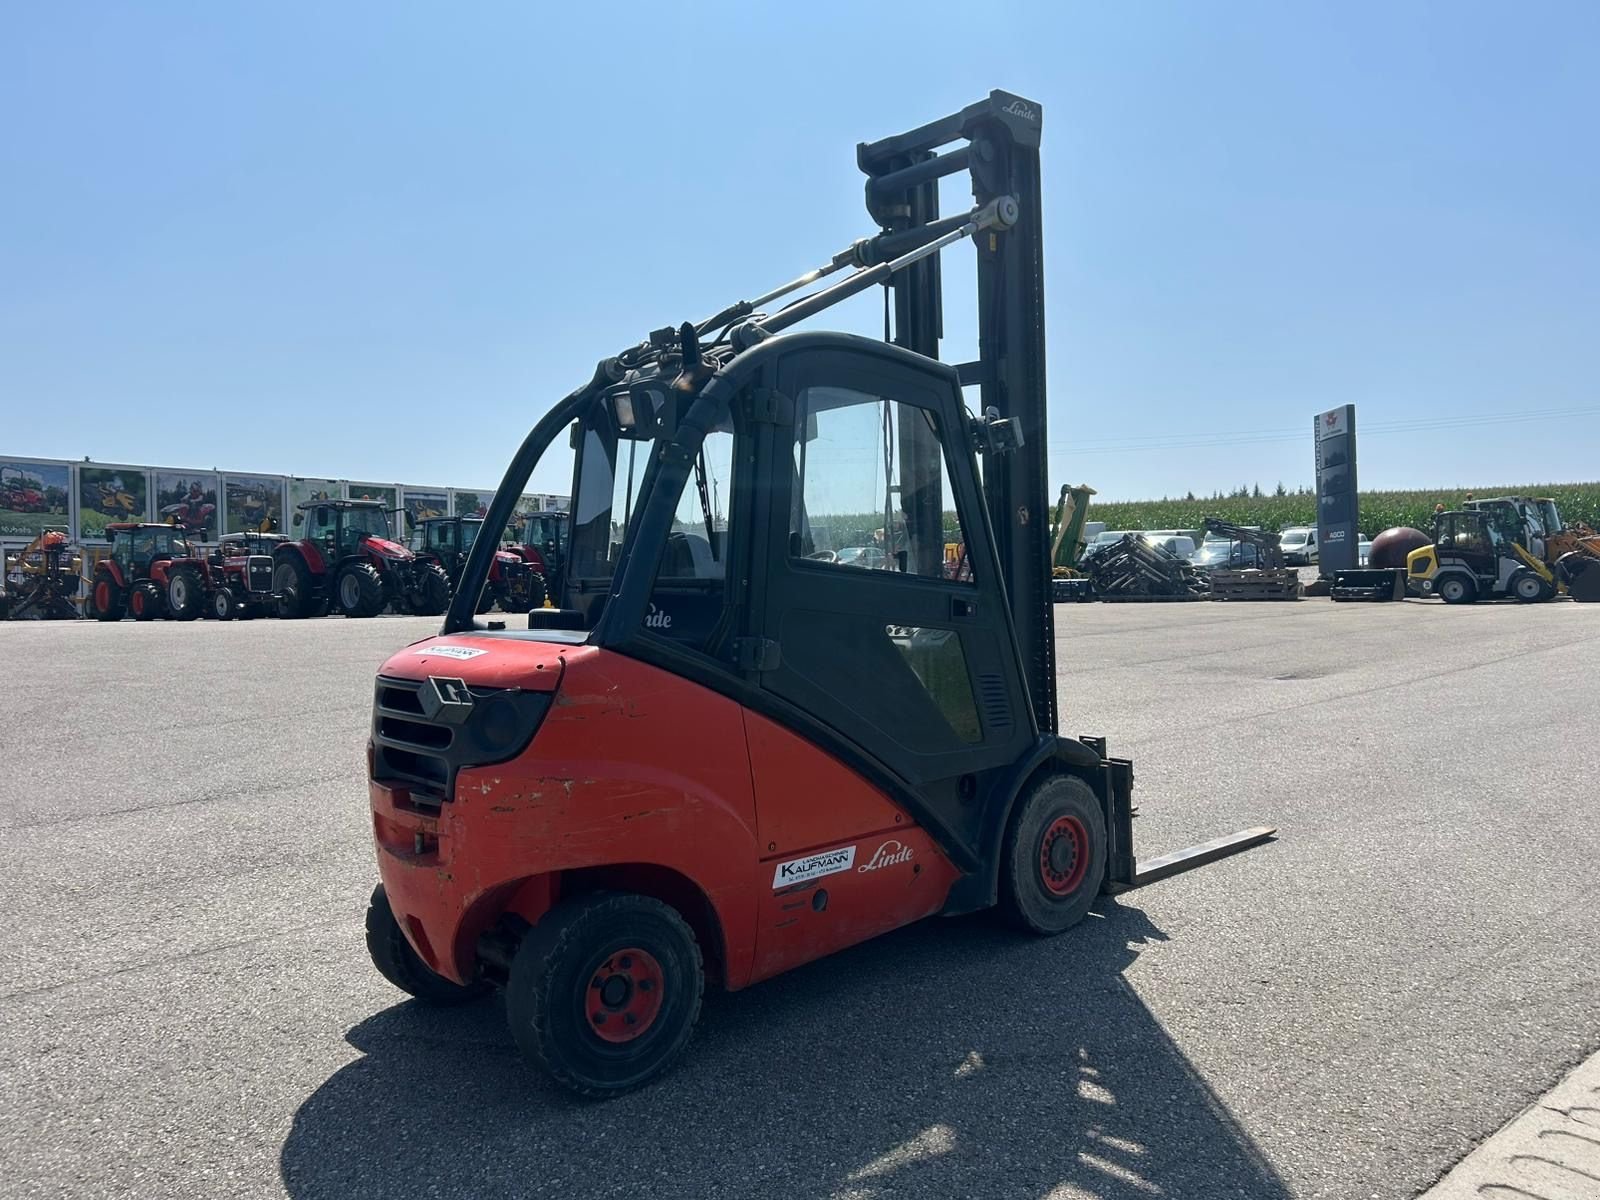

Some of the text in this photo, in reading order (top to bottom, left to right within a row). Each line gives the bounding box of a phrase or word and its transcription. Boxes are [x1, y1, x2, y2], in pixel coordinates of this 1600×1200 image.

[1002, 101, 1036, 121] Linde
[644, 602, 672, 628] nde
[781, 854, 849, 878] KAUFMANN
[857, 840, 914, 873] Linde
